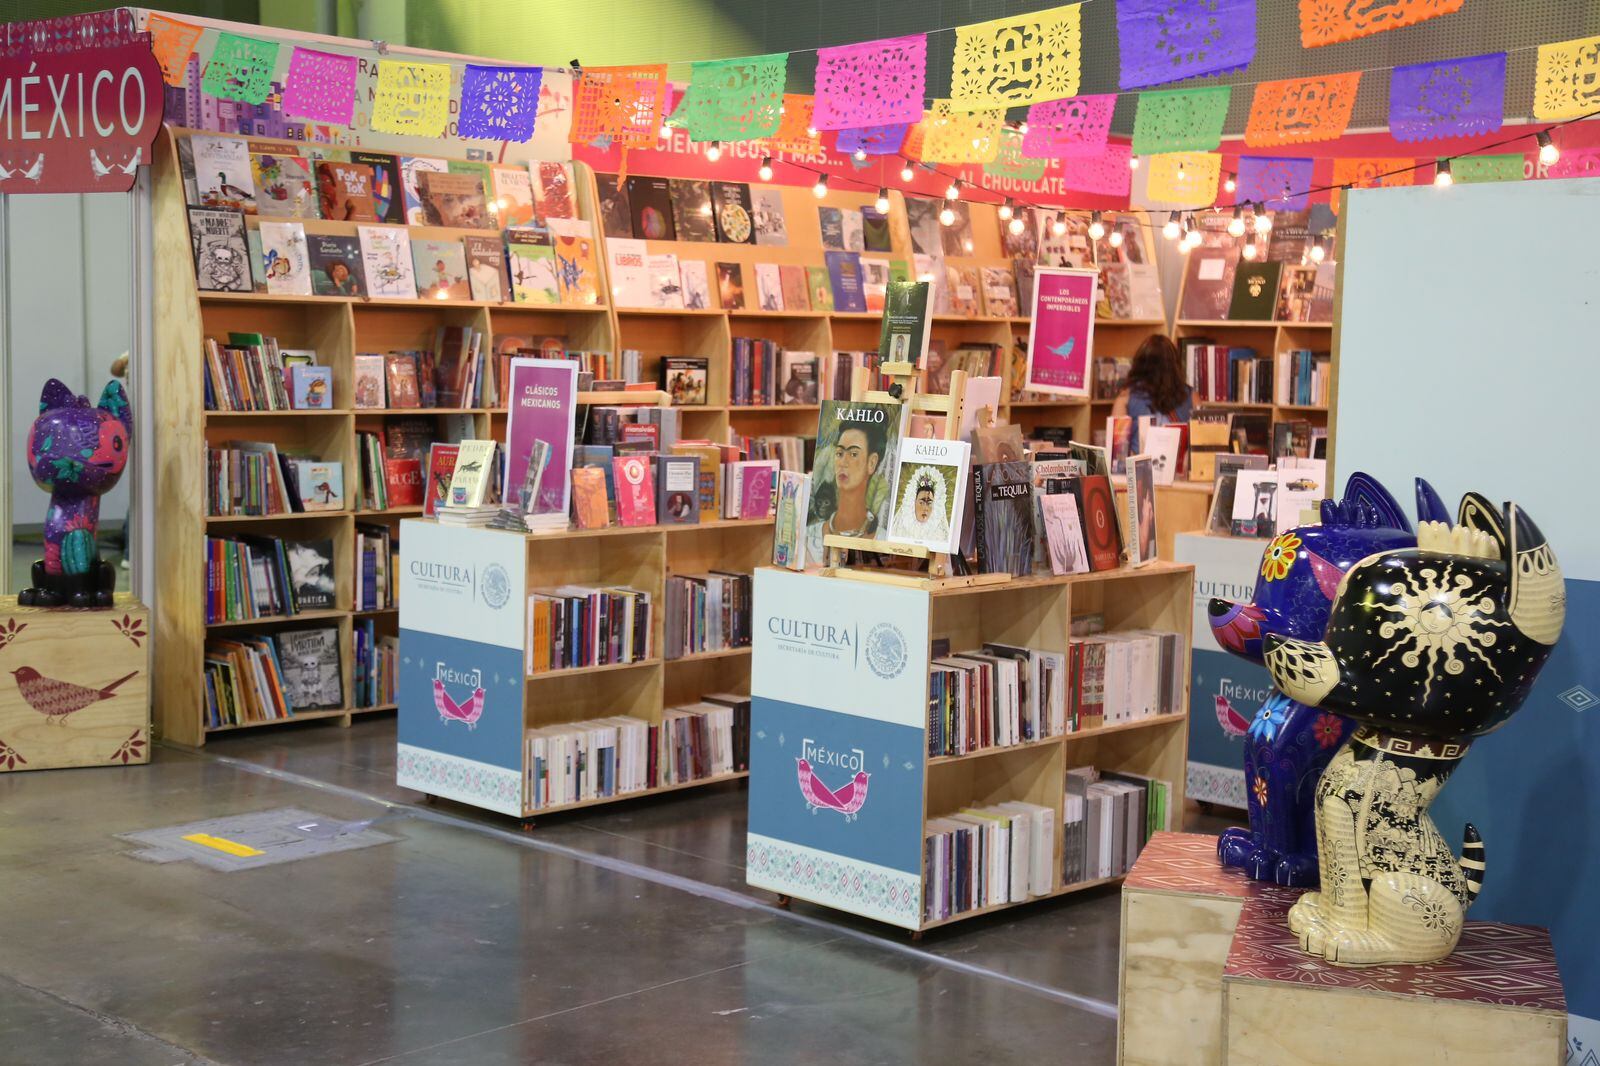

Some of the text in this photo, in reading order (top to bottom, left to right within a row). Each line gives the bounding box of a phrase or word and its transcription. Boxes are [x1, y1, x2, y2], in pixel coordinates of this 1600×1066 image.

[1040, 296, 1088, 305] CONTEMPORÁNEOS
[1046, 303, 1081, 312] IMPERDIBLES
[525, 384, 558, 396] CLÁSICOS
[521, 398, 560, 409] MEXICANOS
[836, 407, 885, 423] KAHLO
[915, 444, 948, 457] KAHLO
[974, 470, 983, 503] TEQUILA
[998, 484, 1028, 498] TEQUILA
[410, 560, 471, 584] CULTURA
[768, 616, 851, 646] CULTURA
[440, 667, 478, 687] MÉXICO
[807, 747, 859, 770] MÉXICO
